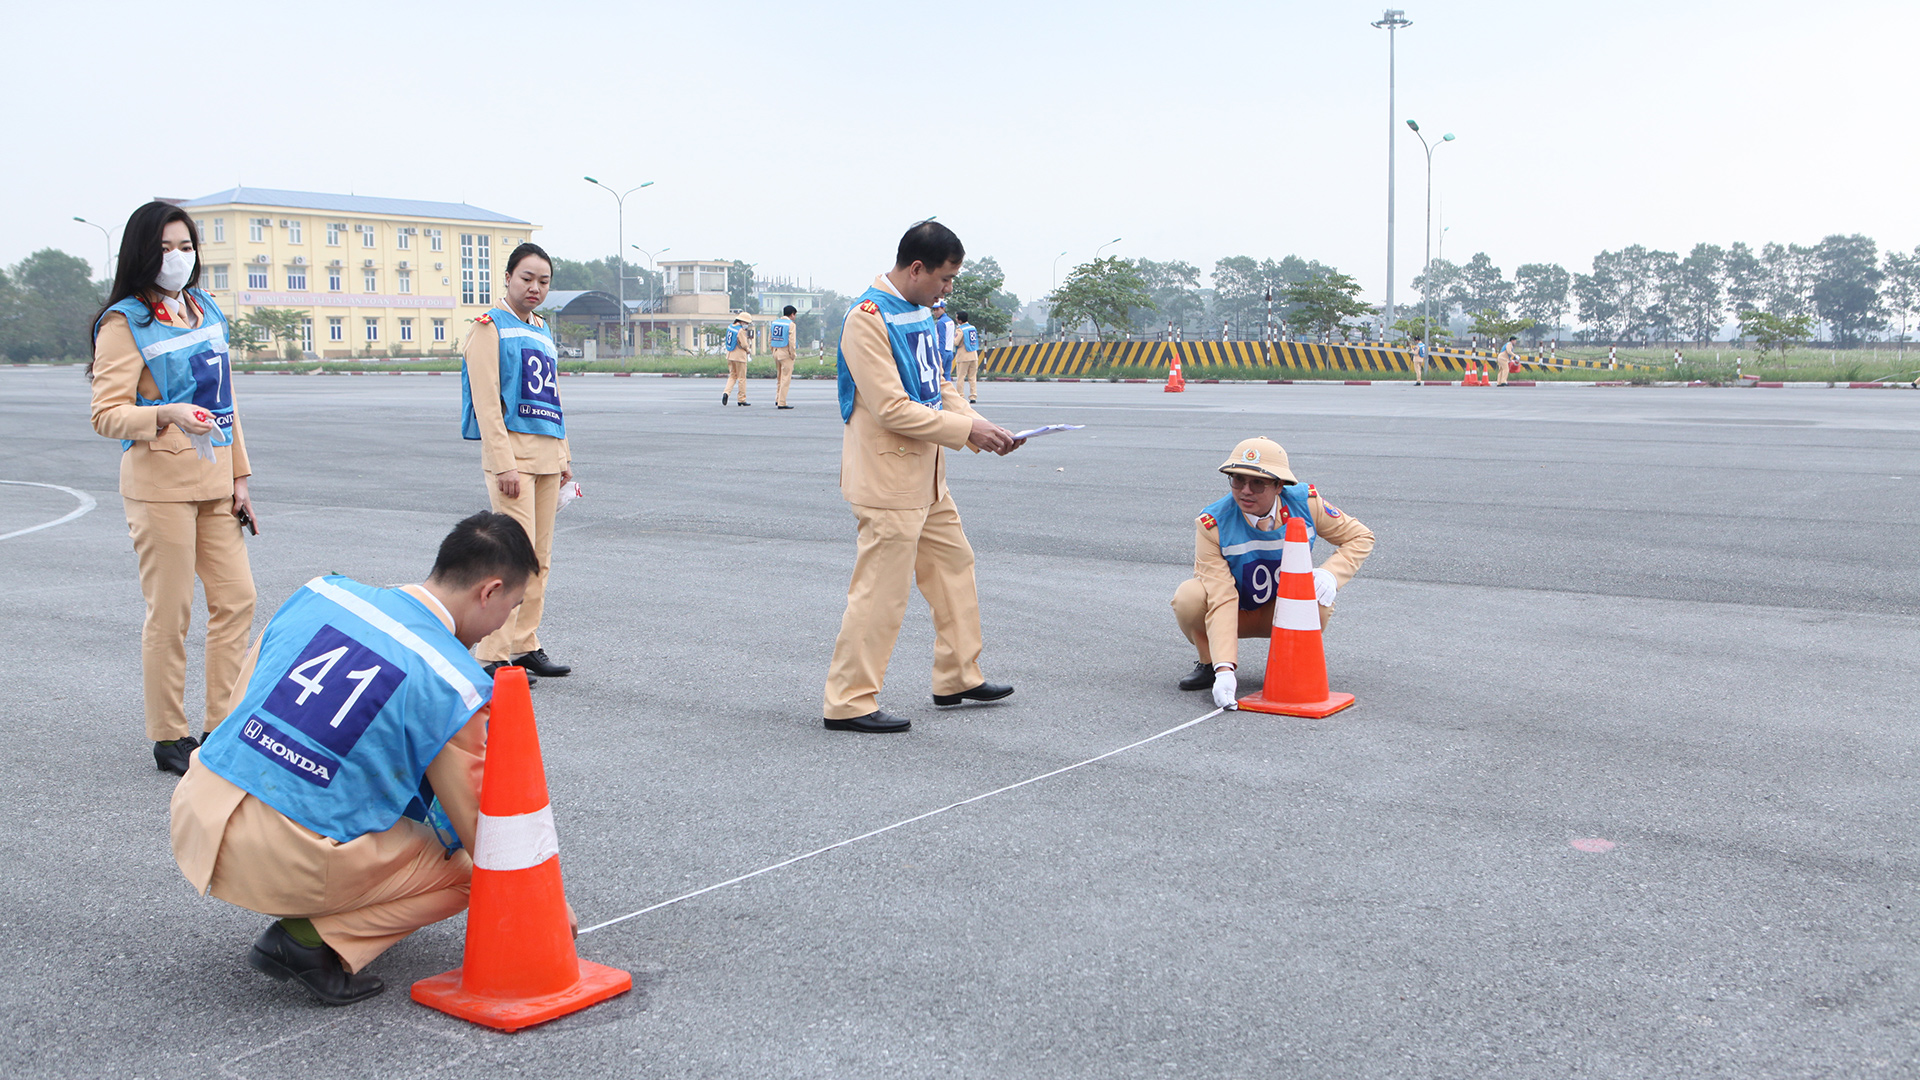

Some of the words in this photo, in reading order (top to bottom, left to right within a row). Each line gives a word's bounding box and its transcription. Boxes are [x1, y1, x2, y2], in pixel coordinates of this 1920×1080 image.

[772, 326, 783, 337] 51
[206, 355, 222, 403] 7
[527, 355, 558, 397] 34
[531, 408, 560, 420] HONDA
[288, 645, 382, 729] 41
[258, 734, 330, 780] HONDA
